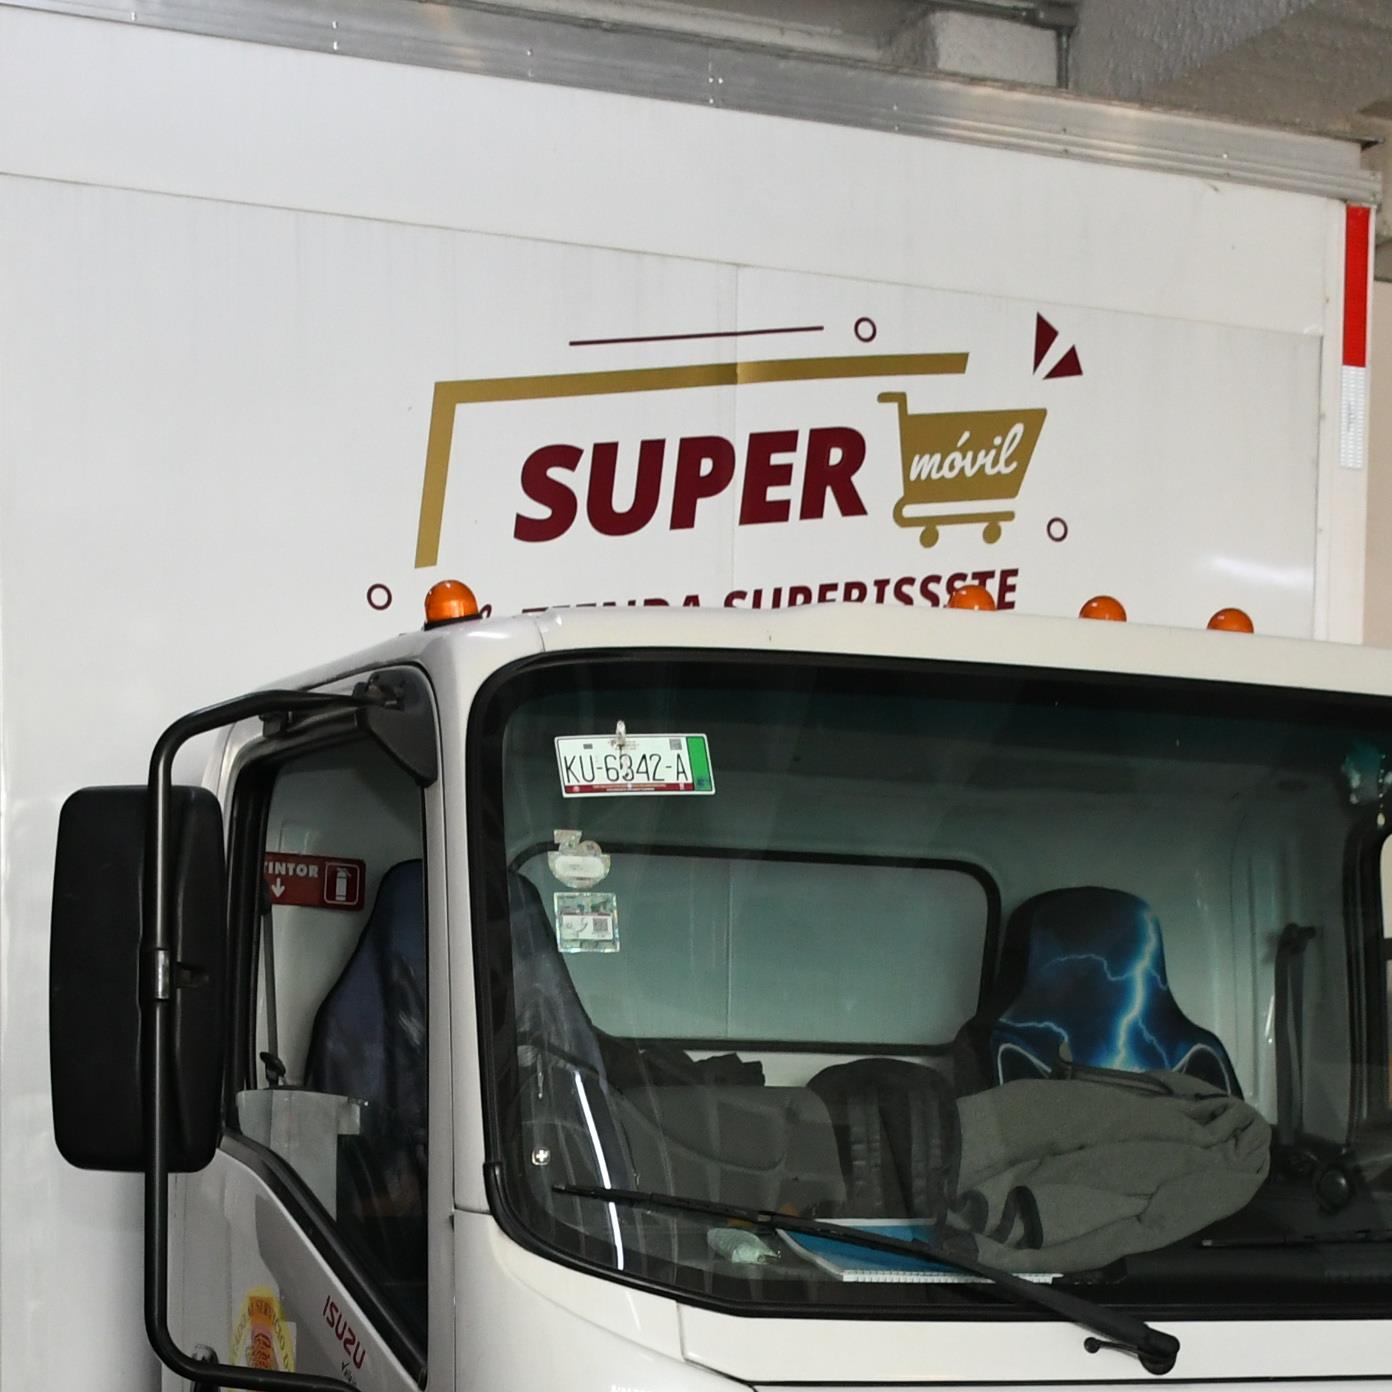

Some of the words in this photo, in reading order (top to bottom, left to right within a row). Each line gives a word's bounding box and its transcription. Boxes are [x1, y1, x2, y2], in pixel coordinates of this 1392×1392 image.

[512, 425, 869, 543] SUPER
[909, 422, 1021, 485] móvil
[265, 862, 318, 879] INTOR
[323, 1295, 366, 1370] ISUZU
